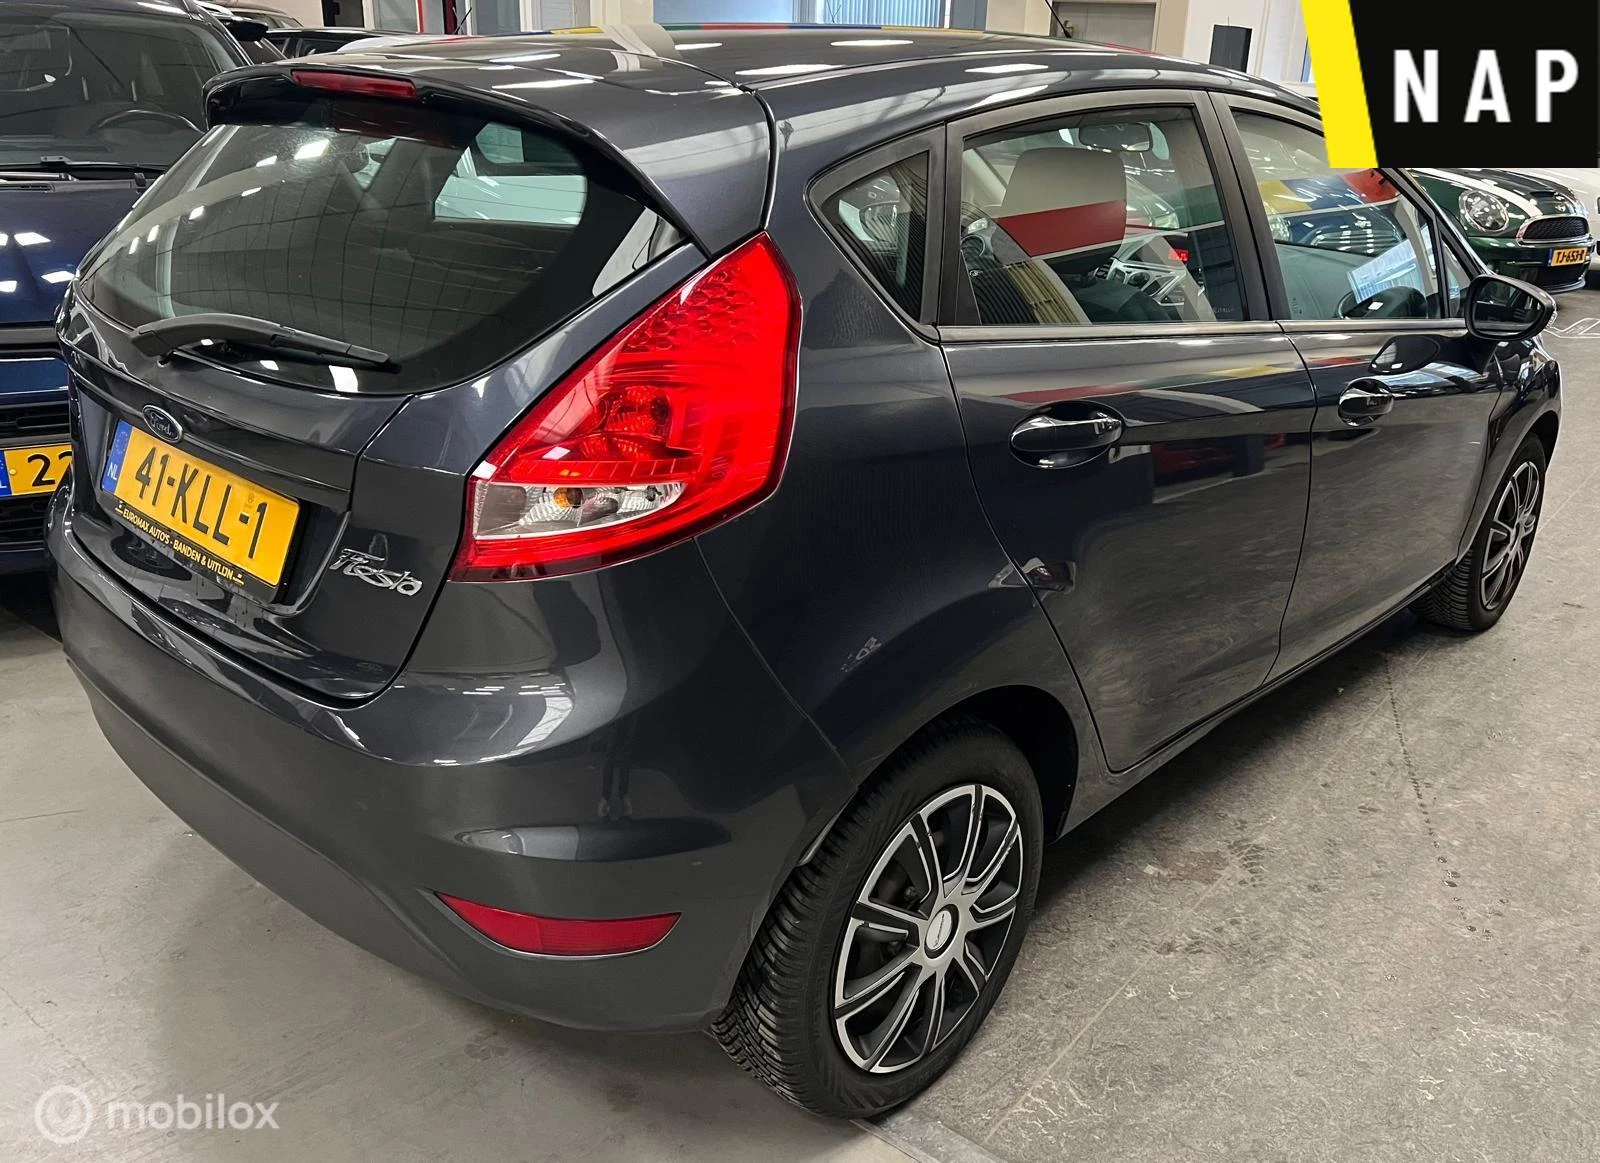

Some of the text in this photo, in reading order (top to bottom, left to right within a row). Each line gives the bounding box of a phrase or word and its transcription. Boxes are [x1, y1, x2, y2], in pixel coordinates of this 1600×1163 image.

[107, 461, 118, 480] NL
[135, 446, 268, 560] 41-KLL-1
[122, 508, 149, 533] EUROMAX
[148, 525, 170, 545] AUTO'S
[172, 538, 202, 563] BANDEN
[200, 555, 207, 566] &
[329, 548, 423, 596] Fiesta
